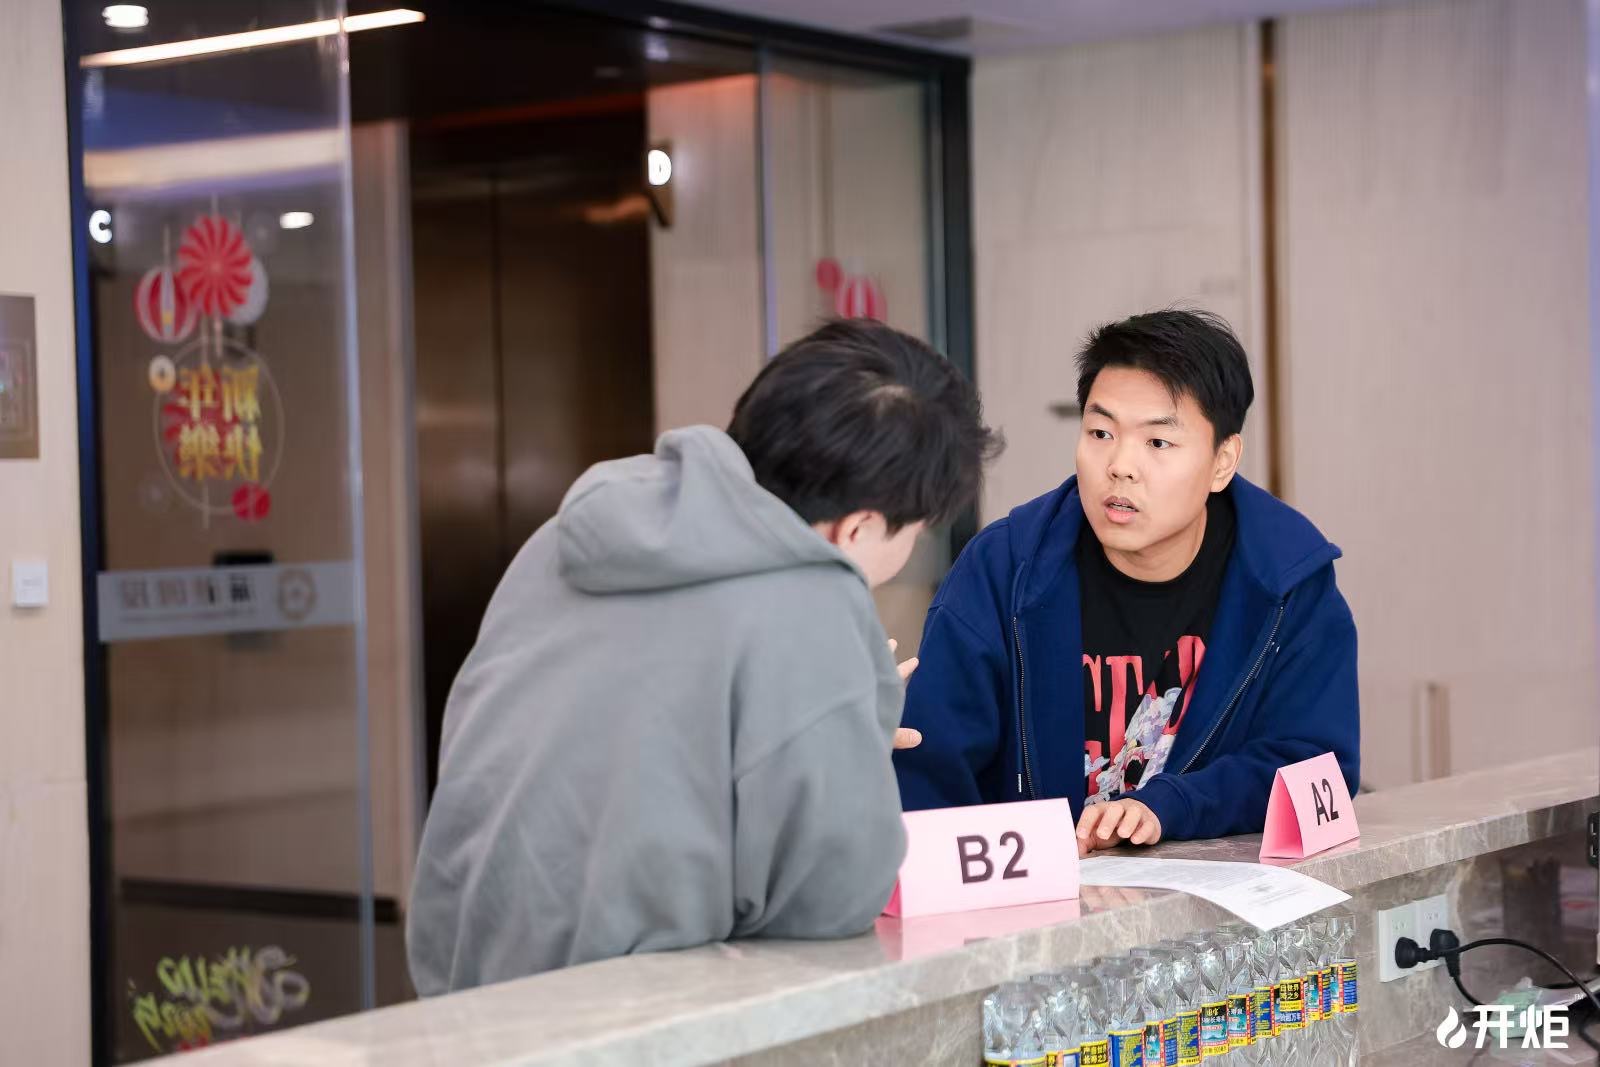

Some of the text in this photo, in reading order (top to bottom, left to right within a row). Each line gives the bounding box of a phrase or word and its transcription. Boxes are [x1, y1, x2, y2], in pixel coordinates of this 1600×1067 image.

[648, 149, 672, 186] D
[89, 209, 113, 244] C
[1311, 778, 1340, 826] A2
[956, 830, 1028, 884] B2
